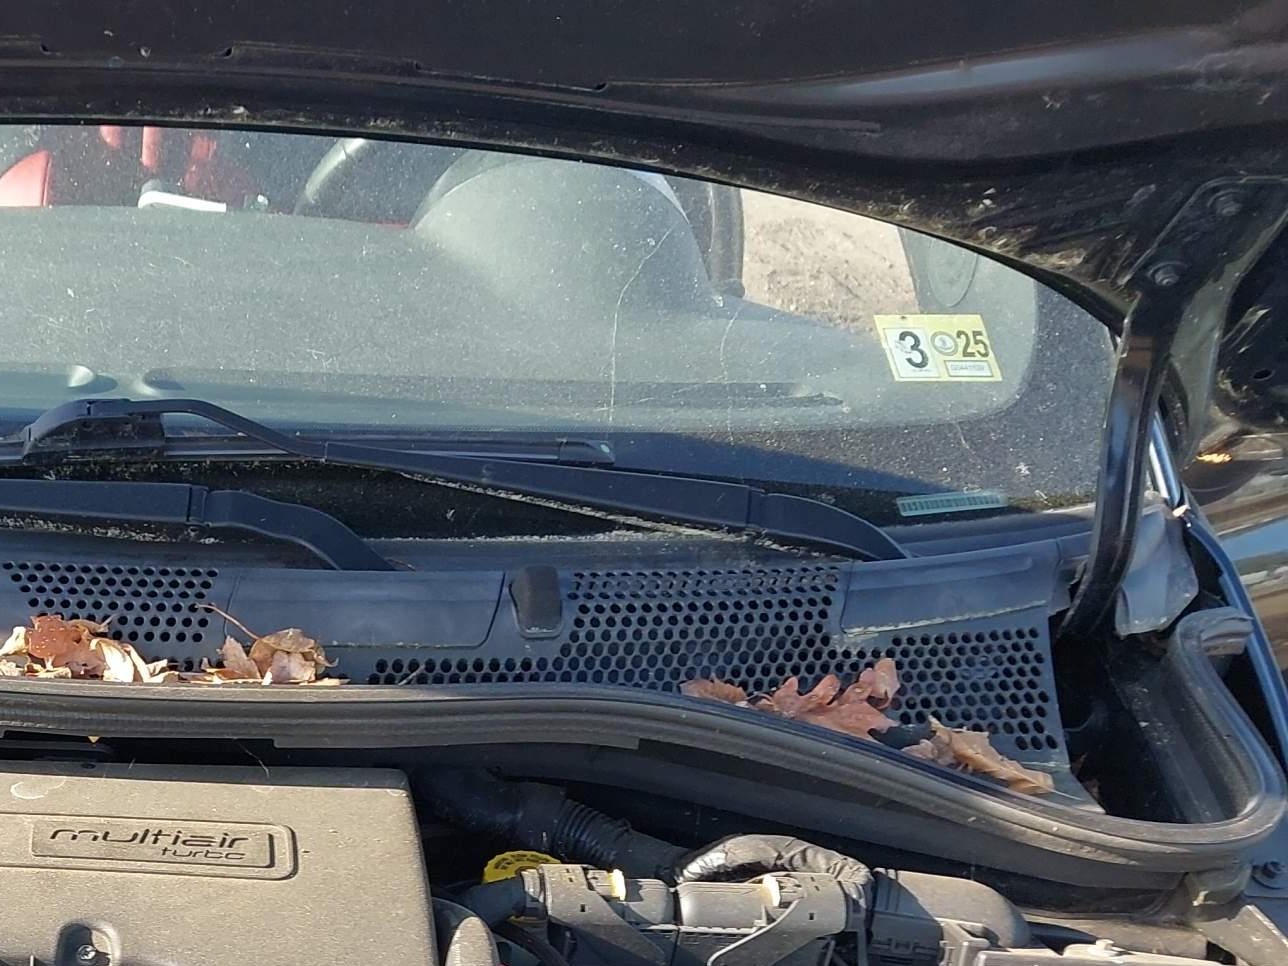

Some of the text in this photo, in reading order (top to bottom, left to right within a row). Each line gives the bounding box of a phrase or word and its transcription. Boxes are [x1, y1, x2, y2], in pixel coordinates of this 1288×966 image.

[898, 330, 990, 368] 3 25
[49, 828, 249, 849] multiair
